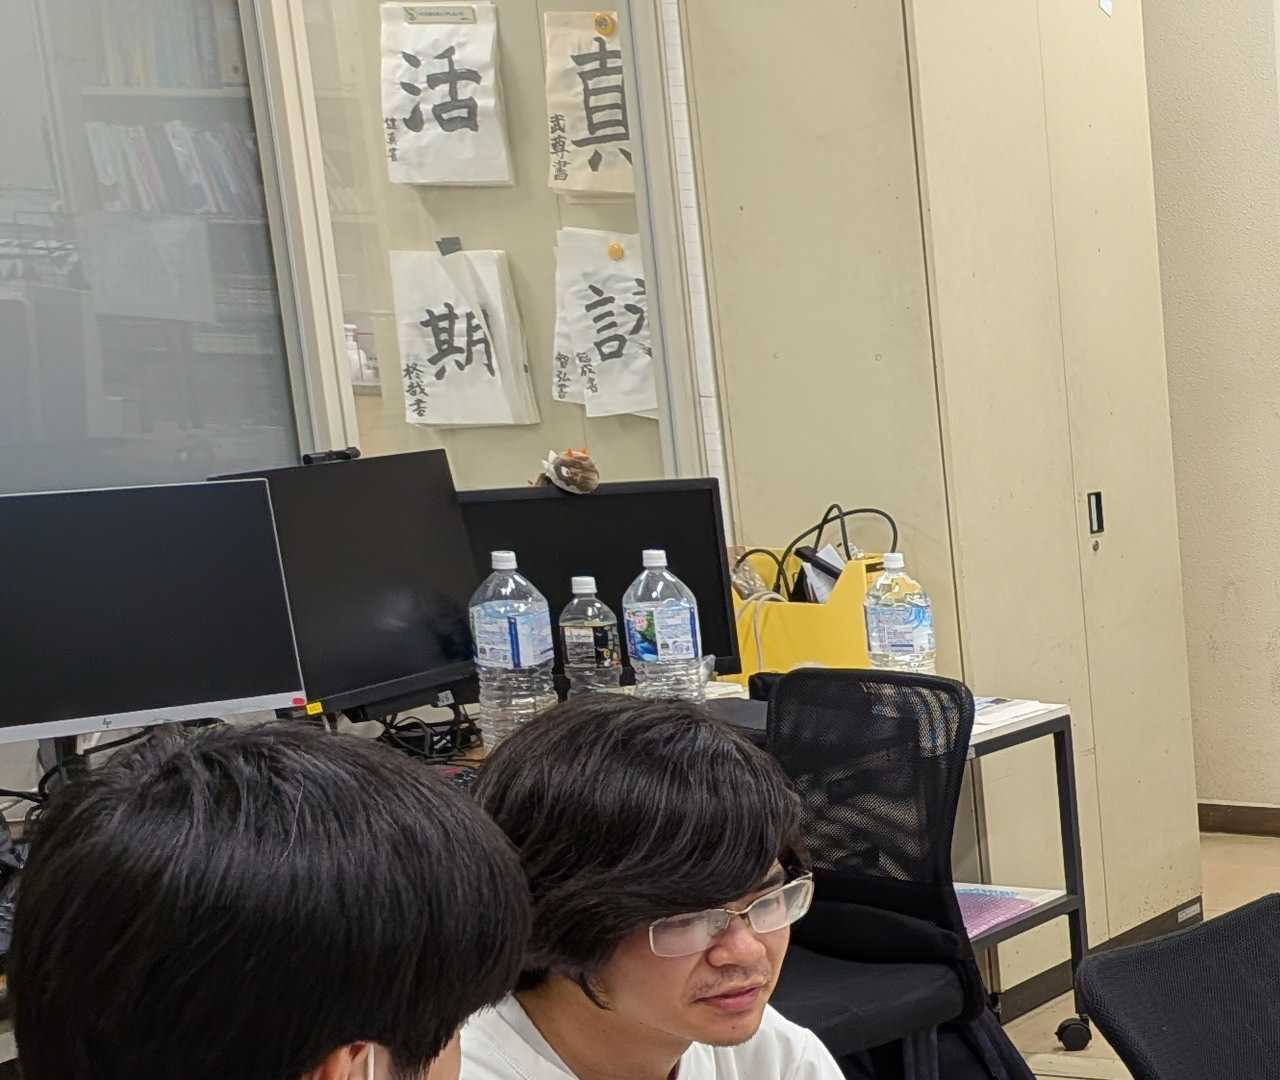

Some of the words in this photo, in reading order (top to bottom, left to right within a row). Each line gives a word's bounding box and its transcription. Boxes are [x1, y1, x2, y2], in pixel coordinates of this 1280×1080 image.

[400, 45, 482, 132] 活
[570, 36, 634, 172] 真
[420, 302, 496, 381] 期
